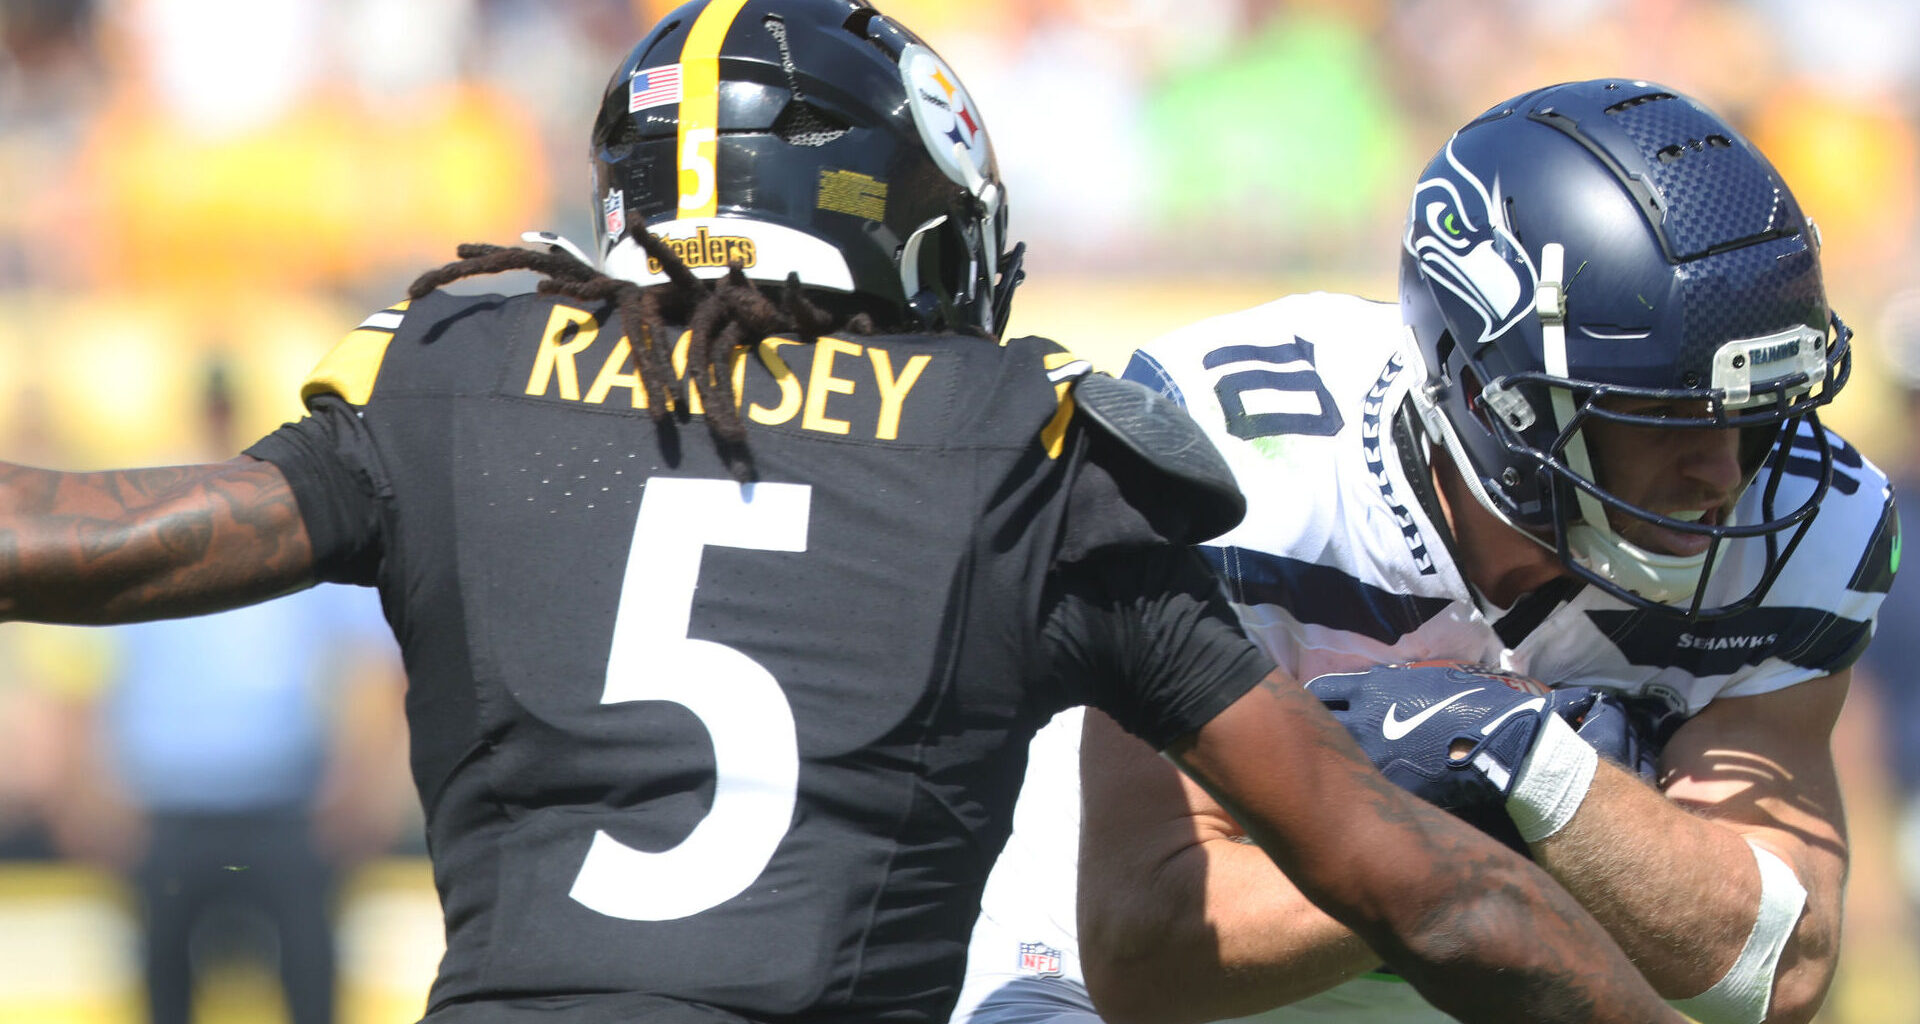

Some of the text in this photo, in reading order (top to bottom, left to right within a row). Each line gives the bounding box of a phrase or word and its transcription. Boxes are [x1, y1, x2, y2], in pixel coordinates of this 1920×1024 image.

[680, 127, 715, 210] 5
[647, 226, 757, 274] eelers
[1202, 335, 1345, 441] 10
[568, 476, 812, 922] 5
[1023, 954, 1060, 972] NFL
